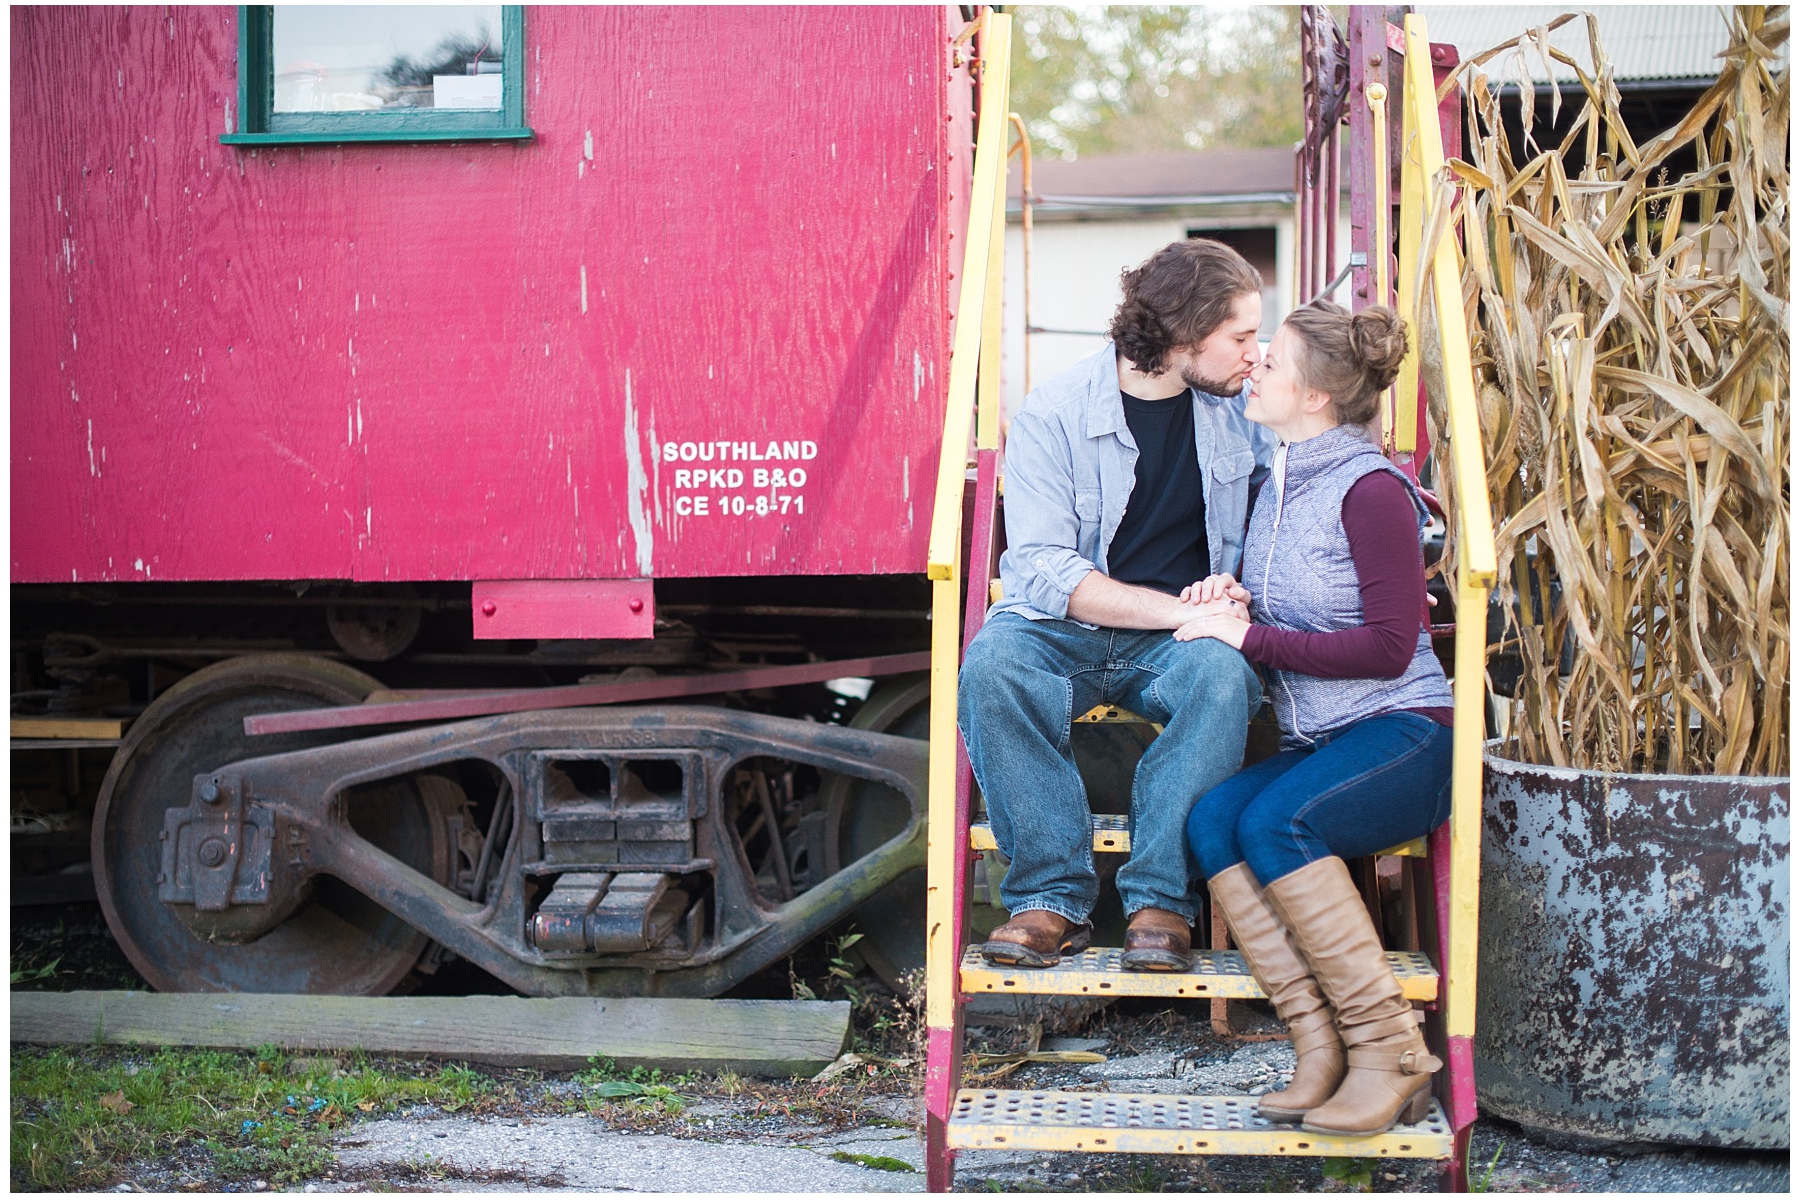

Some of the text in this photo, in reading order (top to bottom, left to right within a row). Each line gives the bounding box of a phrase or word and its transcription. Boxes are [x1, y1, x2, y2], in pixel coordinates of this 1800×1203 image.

[663, 440, 818, 462] SOUTHLAND
[675, 468, 807, 489] RPKD B&O
[676, 495, 804, 516] CE 10-8-71
